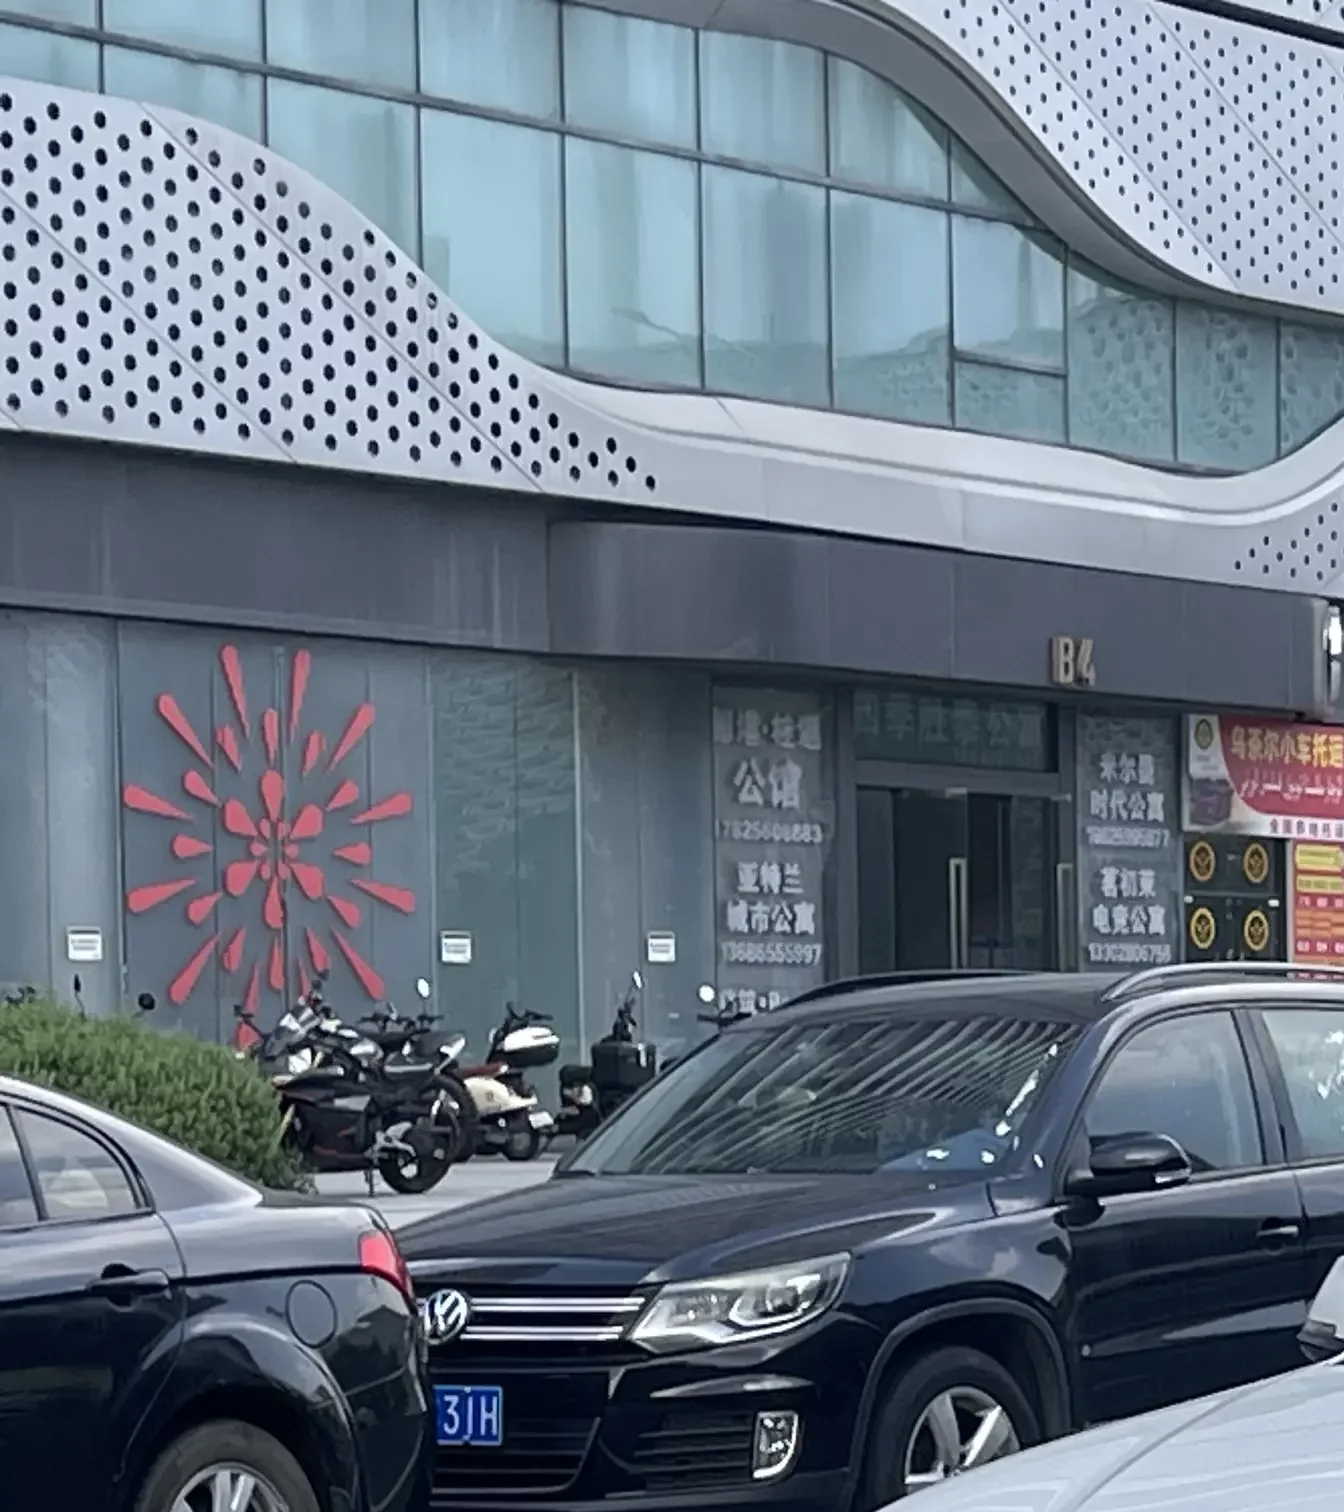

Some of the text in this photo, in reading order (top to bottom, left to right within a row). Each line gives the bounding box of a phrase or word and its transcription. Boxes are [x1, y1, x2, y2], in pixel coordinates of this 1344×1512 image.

[1051, 635, 1096, 687] B4
[737, 861, 804, 894] 亚特兰
[726, 896, 816, 935] 城市公寓
[435, 1394, 498, 1436] 31H
